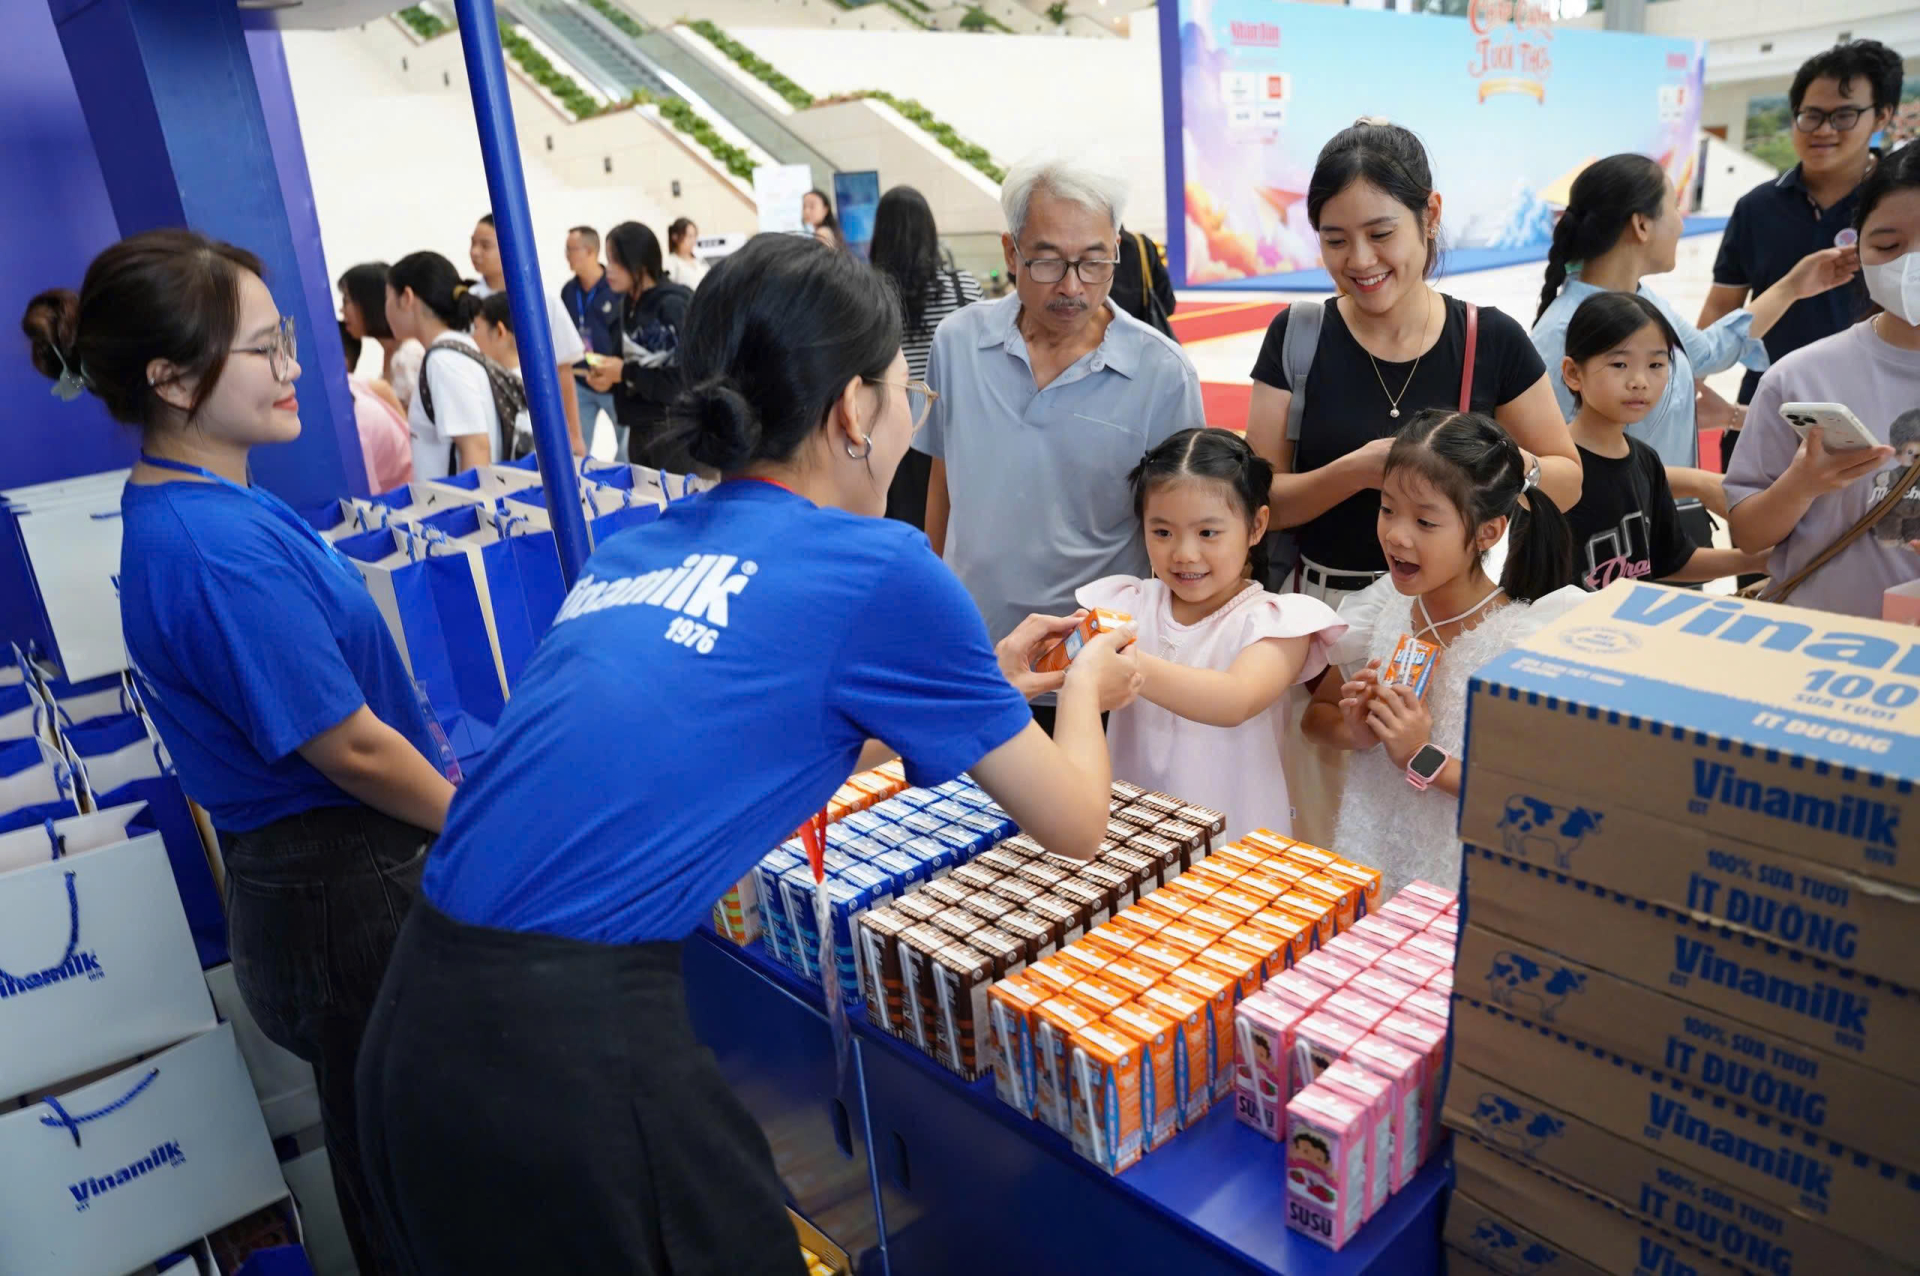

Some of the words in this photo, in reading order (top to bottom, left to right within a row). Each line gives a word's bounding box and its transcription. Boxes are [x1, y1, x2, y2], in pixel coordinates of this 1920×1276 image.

[664, 616, 719, 654] 1976
[1693, 757, 1898, 848] Vinamilk
[1674, 934, 1869, 1035] Vinamilk
[67, 1138, 184, 1203] Vinamilk
[1649, 1092, 1833, 1199] Vinamilk
[1289, 1202, 1333, 1239] SUSU
